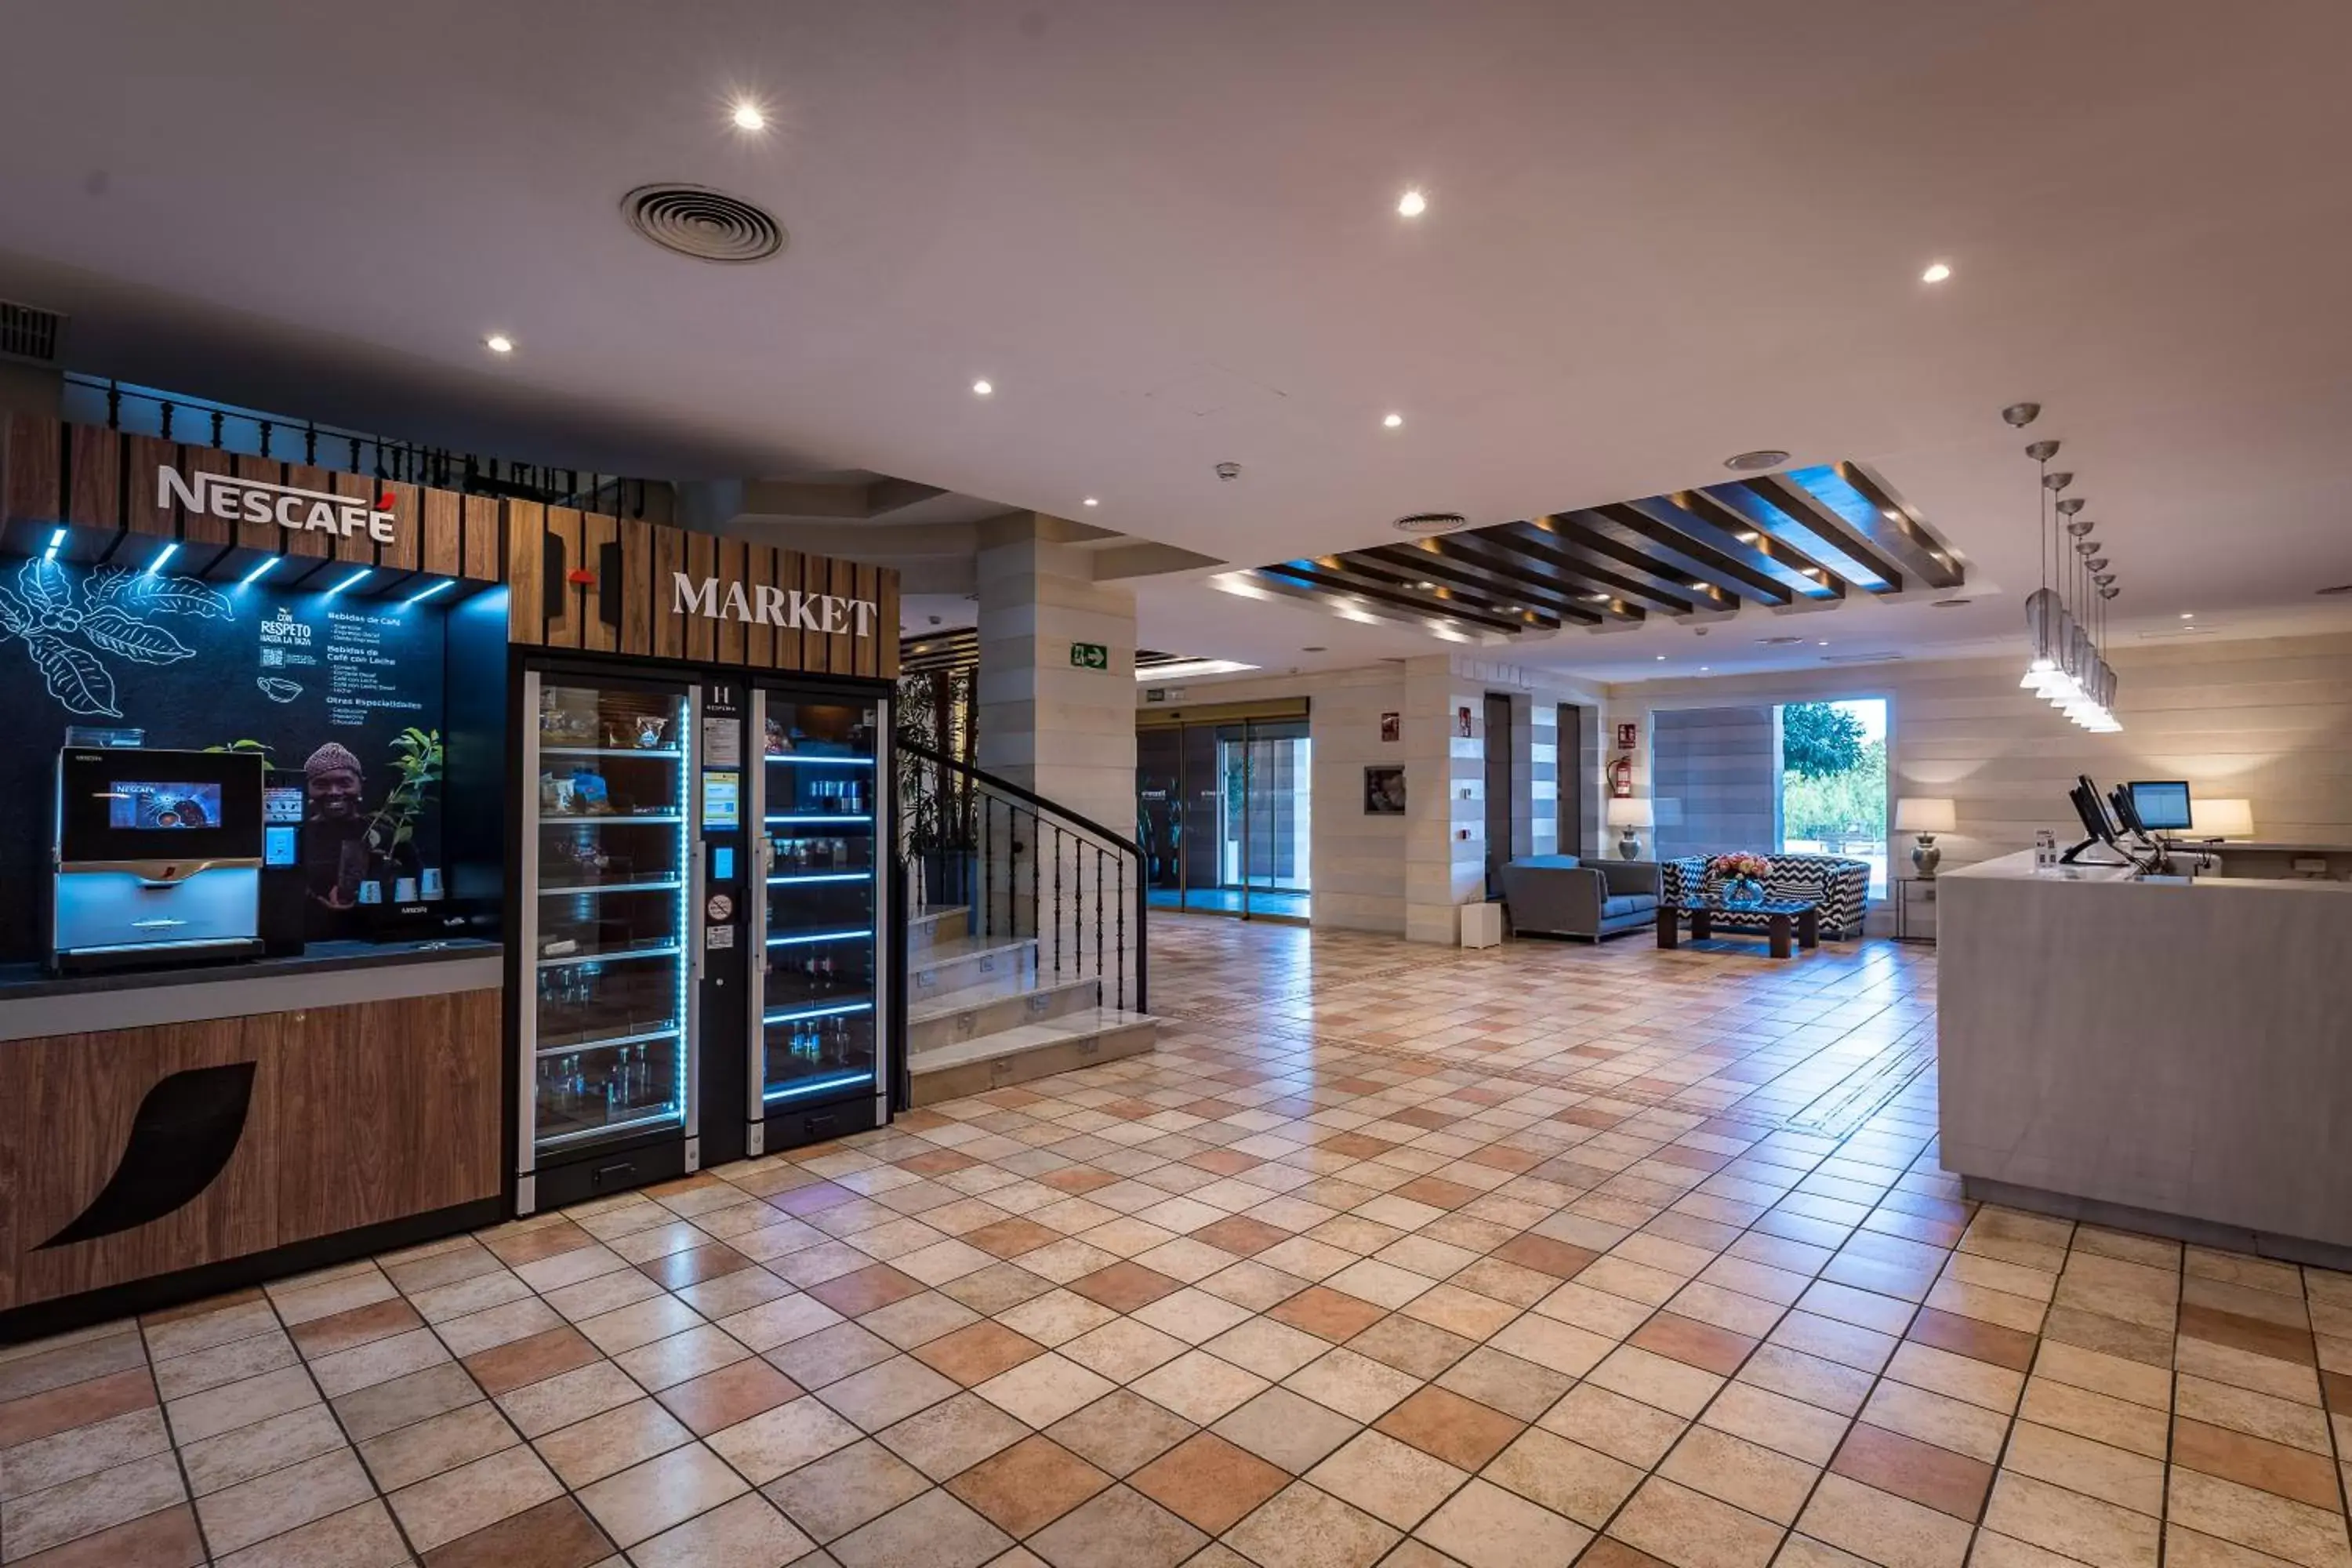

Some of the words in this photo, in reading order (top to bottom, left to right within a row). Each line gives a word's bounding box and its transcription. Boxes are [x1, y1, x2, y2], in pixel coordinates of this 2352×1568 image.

[158, 465, 397, 543] NESCAFÉ
[673, 572, 877, 637] MARKET
[277, 612, 293, 622] CON
[260, 620, 311, 637] RESPETO
[327, 645, 365, 655] Bebidas
[327, 653, 349, 662] Café
